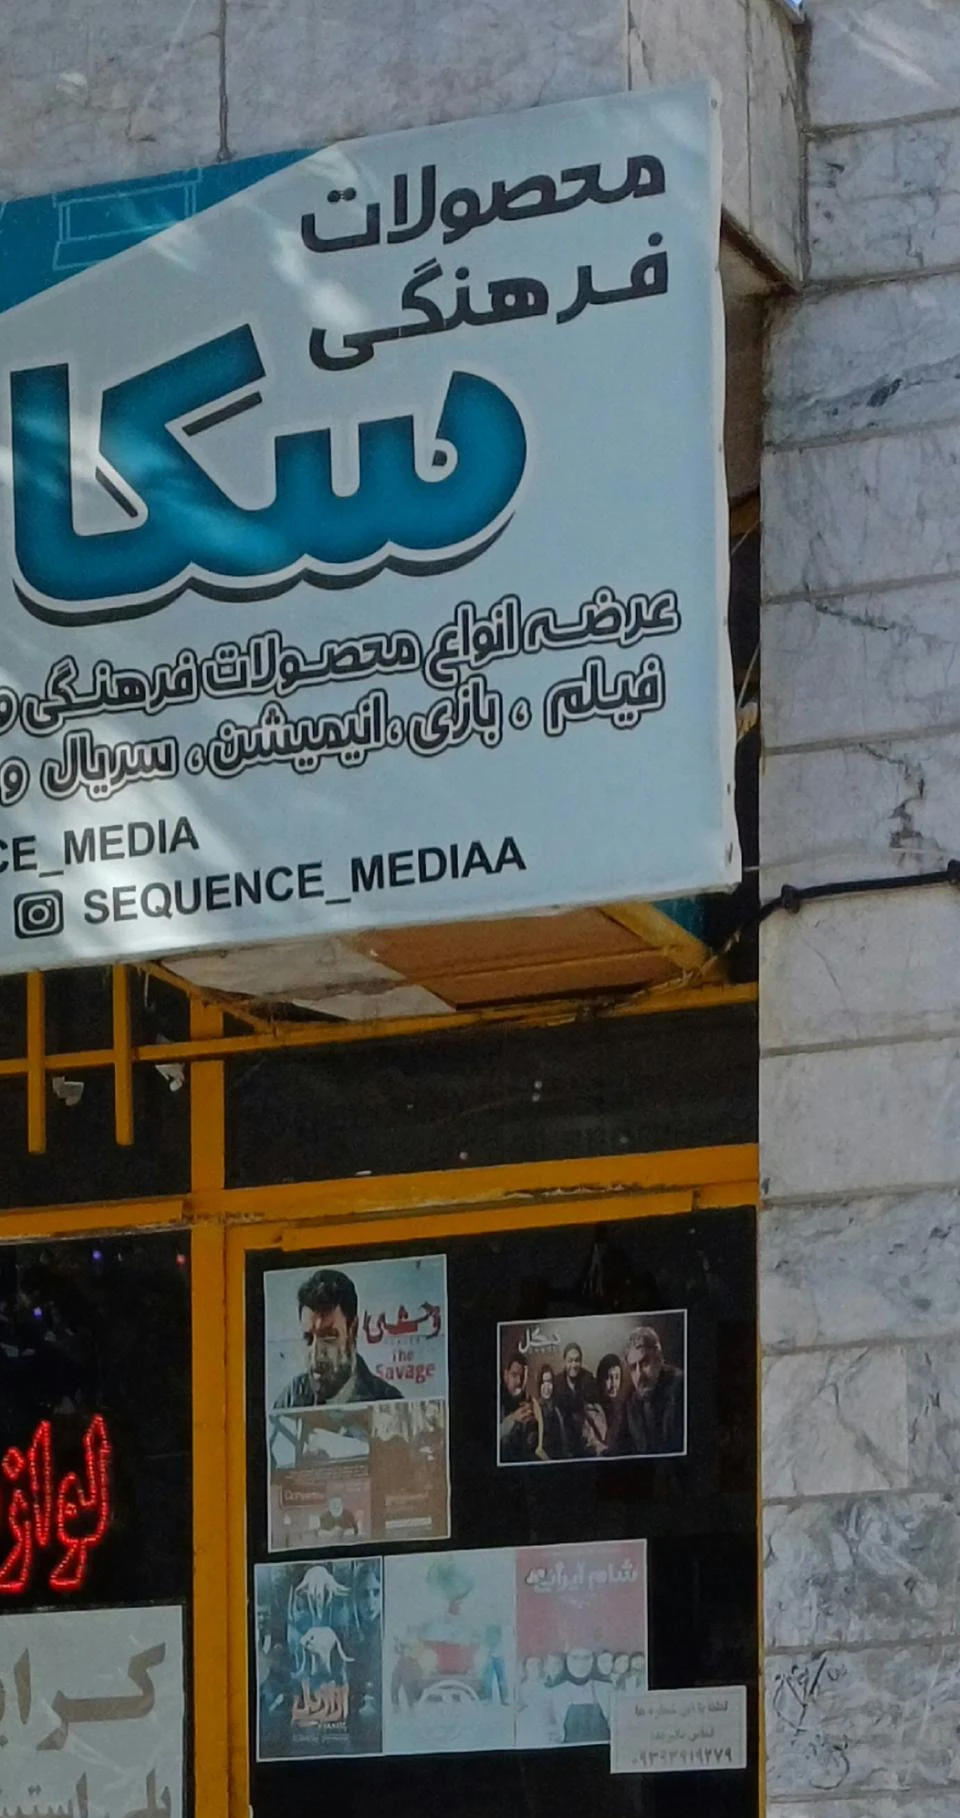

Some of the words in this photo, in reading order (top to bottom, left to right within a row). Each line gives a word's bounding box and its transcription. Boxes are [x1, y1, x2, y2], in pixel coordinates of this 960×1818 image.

[300, 152, 667, 253] محصولات
[309, 231, 669, 372] فرهنگی
[424, 594, 521, 690] انواع
[524, 586, 681, 654] عرضه
[23, 644, 200, 735] فرهنگی
[201, 629, 423, 699] محصولات
[543, 653, 666, 737] فیلم
[40, 729, 179, 801] سریال
[83, 836, 527, 926] SEQUENCE_MEDIAA
[375, 1362, 437, 1384] Savage
